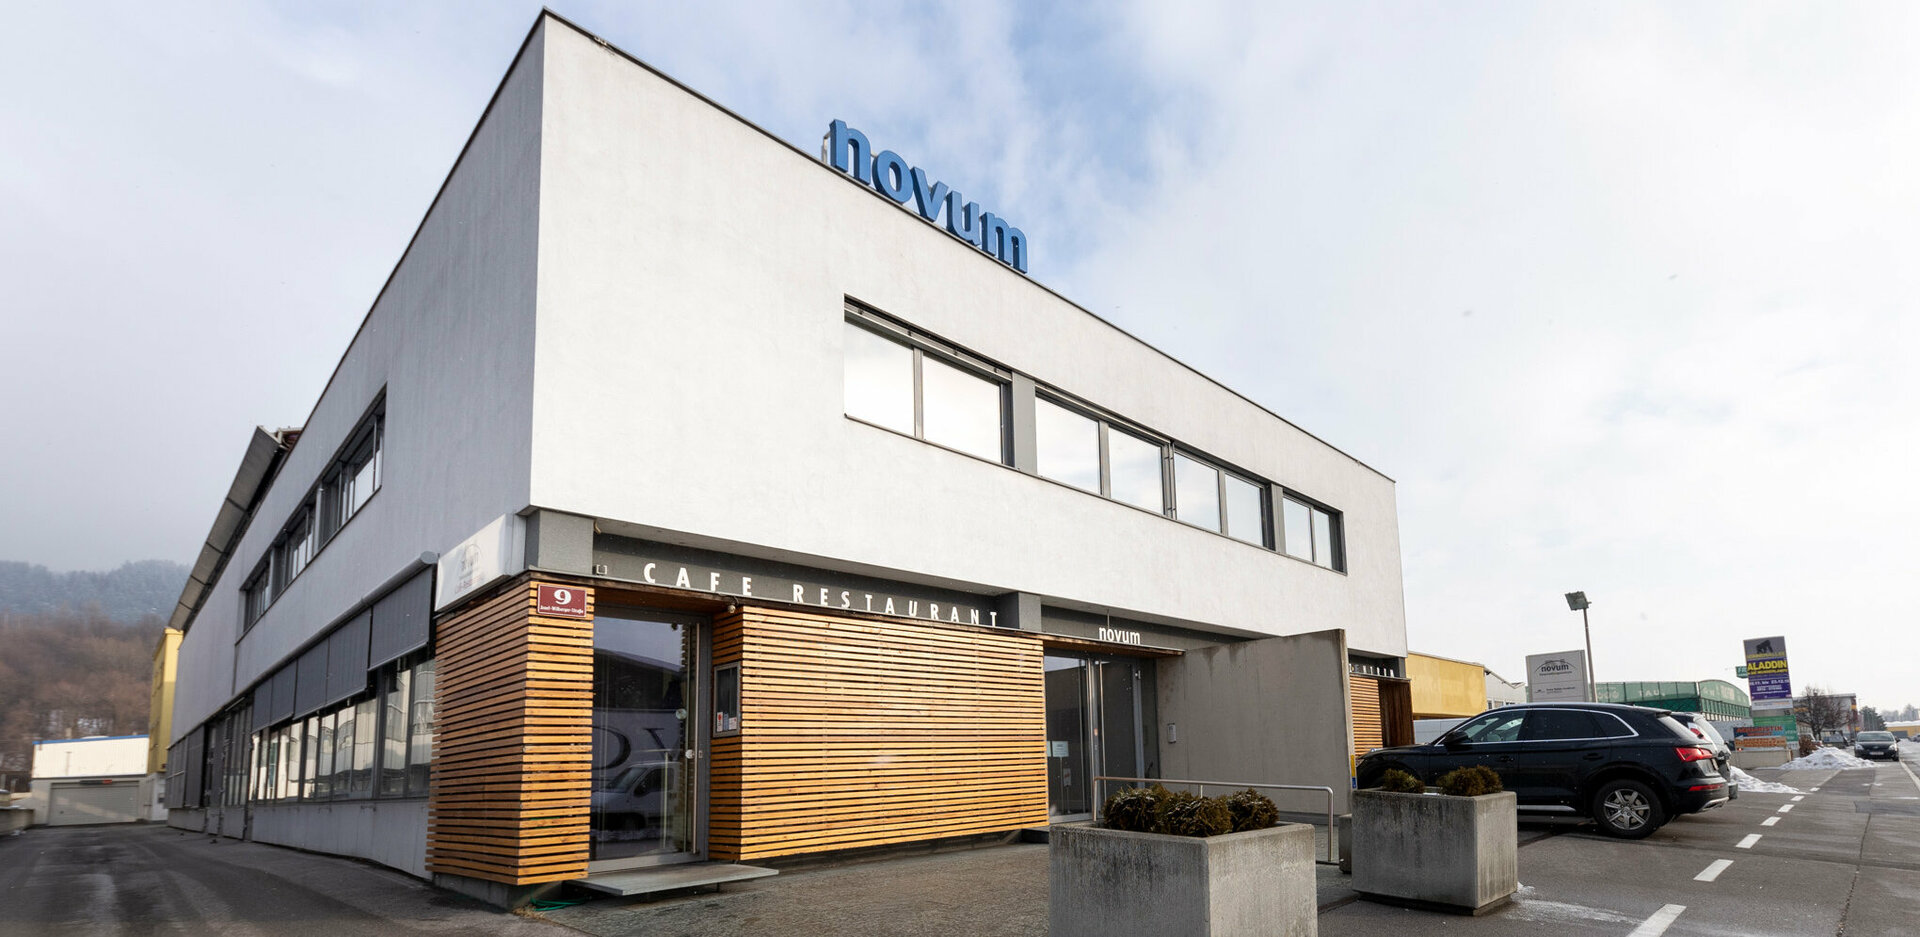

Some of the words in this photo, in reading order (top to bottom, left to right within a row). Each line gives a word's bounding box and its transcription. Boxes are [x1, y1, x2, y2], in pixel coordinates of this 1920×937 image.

[829, 119, 1027, 274] novum
[554, 589, 572, 605] 9
[643, 562, 752, 596] CAFE
[793, 584, 997, 627] RESTAURANT
[1098, 626, 1141, 645] novum
[1541, 664, 1569, 672] novum
[1747, 660, 1787, 671] ALADDIN
